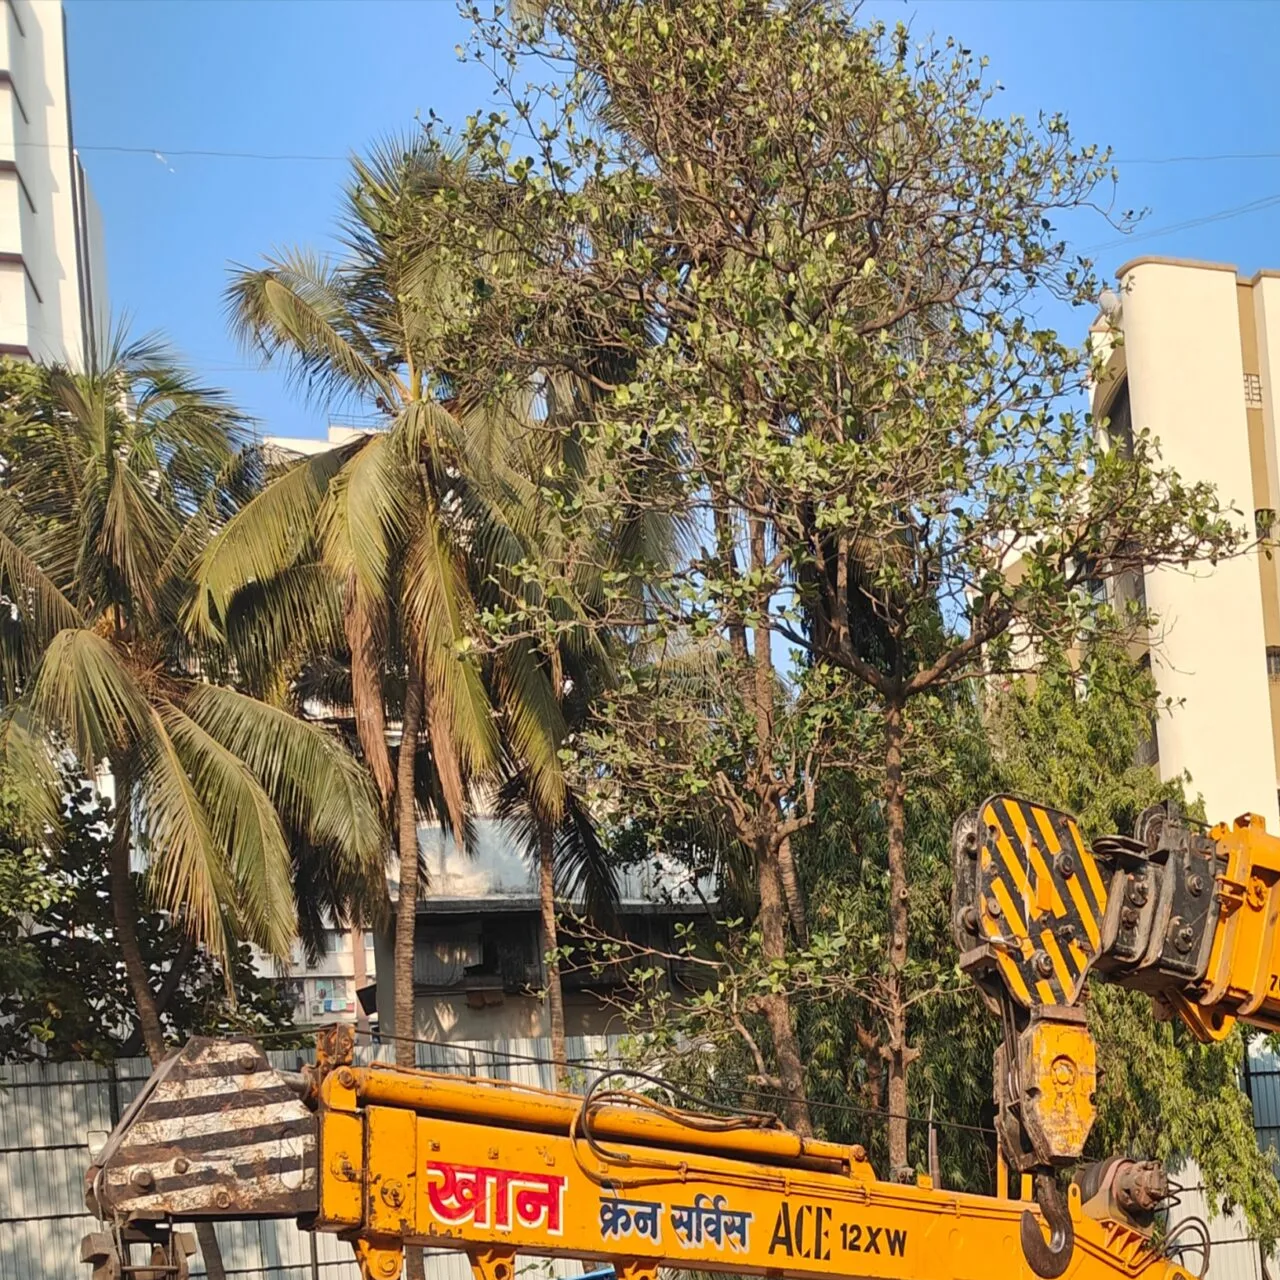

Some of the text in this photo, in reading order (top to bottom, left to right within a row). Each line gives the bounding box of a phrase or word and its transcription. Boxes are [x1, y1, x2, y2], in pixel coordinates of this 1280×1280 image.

[426, 1160, 569, 1236] खान
[670, 1193, 754, 1252] सर्विस
[768, 1201, 832, 1261] ACE
